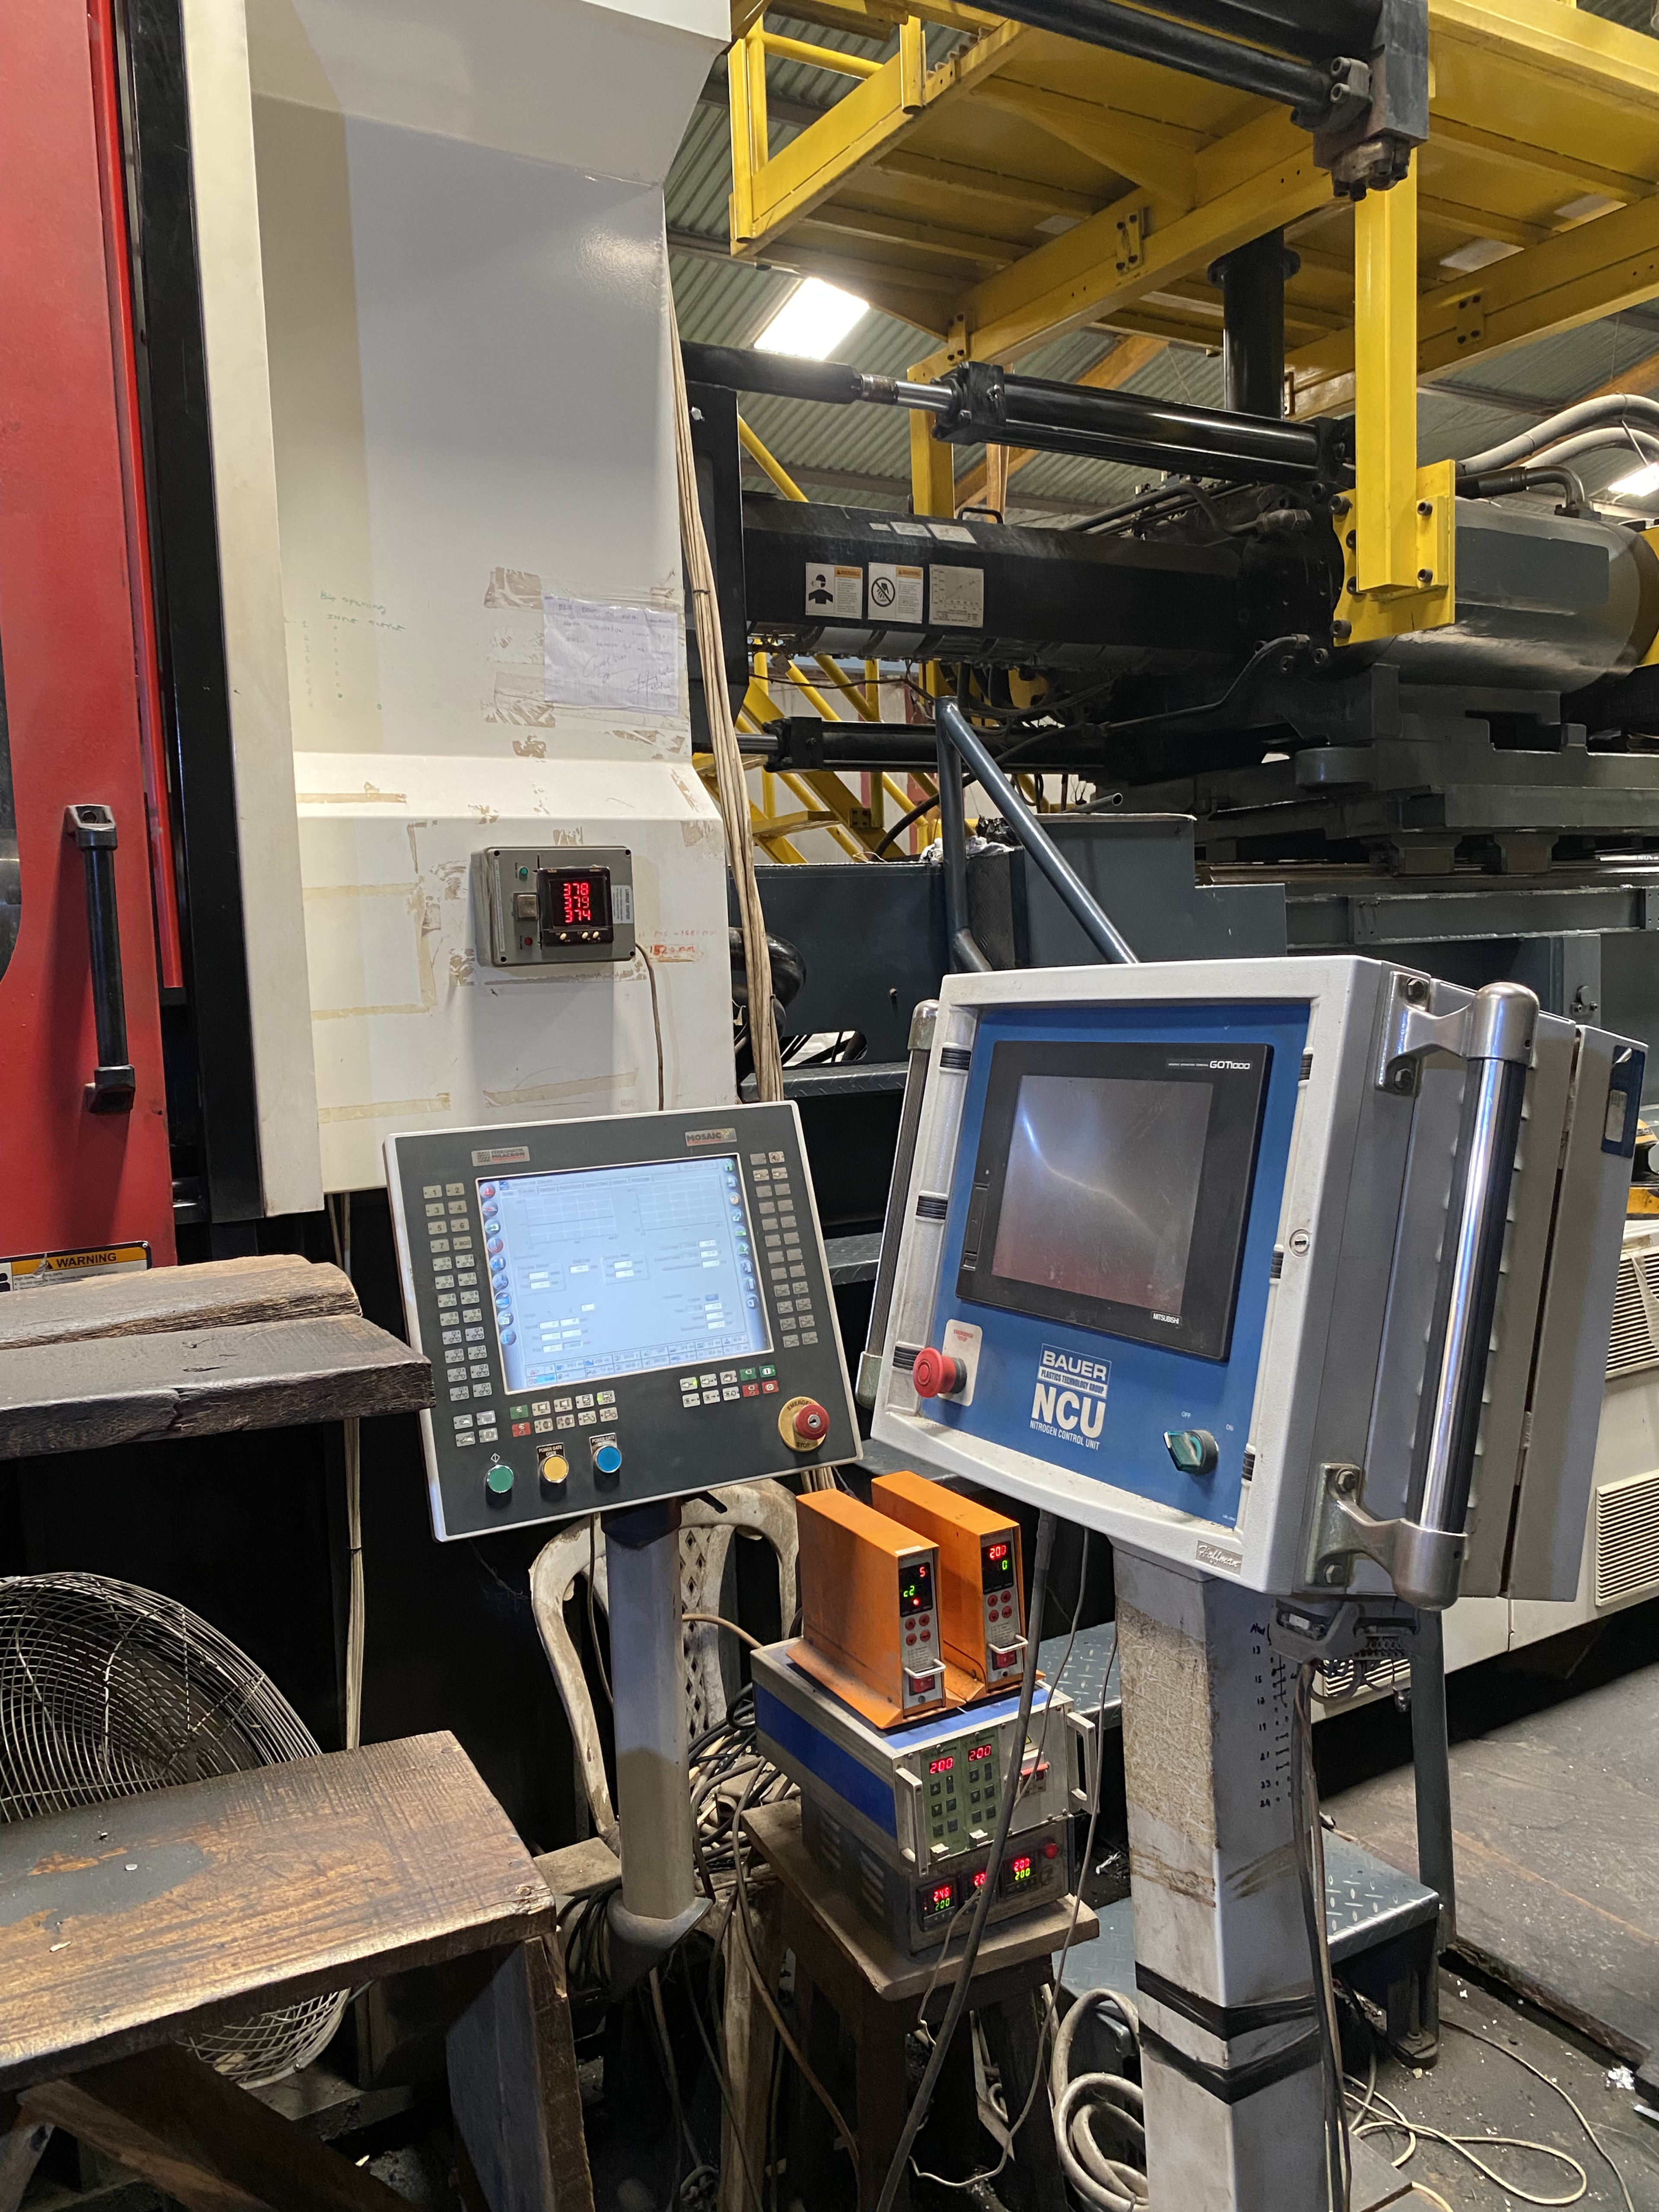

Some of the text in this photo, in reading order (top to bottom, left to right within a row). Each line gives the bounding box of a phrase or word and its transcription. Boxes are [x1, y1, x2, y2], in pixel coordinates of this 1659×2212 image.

[563, 883, 589, 896] 378
[564, 896, 590, 909] 379
[565, 909, 591, 923] 374
[1209, 1060, 1250, 1070] GOT1000
[686, 1132, 721, 1141] MOSAIC
[57, 1252, 117, 1268] WARNING
[1153, 1313, 1179, 1324] MITSUBISHI
[1042, 1350, 1107, 1381] BAUER
[1041, 1369, 1104, 1394] PLASTICS TECHNOLOGY GROUP
[787, 1400, 812, 1411] EMERGE
[1031, 1383, 1106, 1438] NCU
[1030, 1420, 1100, 1450] NITROGEN CONTROL UNIT
[989, 1545, 1006, 1559] 200
[1002, 1560, 1007, 1570] 0
[1253, 1646, 1261, 1655] 13
[1255, 1675, 1262, 1683] 15
[969, 1745, 991, 1761] 200
[930, 1757, 953, 1774] 200
[1014, 1858, 1030, 1872] 200
[974, 1873, 985, 1886] 22
[1015, 1868, 1030, 1881] 200
[935, 1897, 950, 1911] 200
